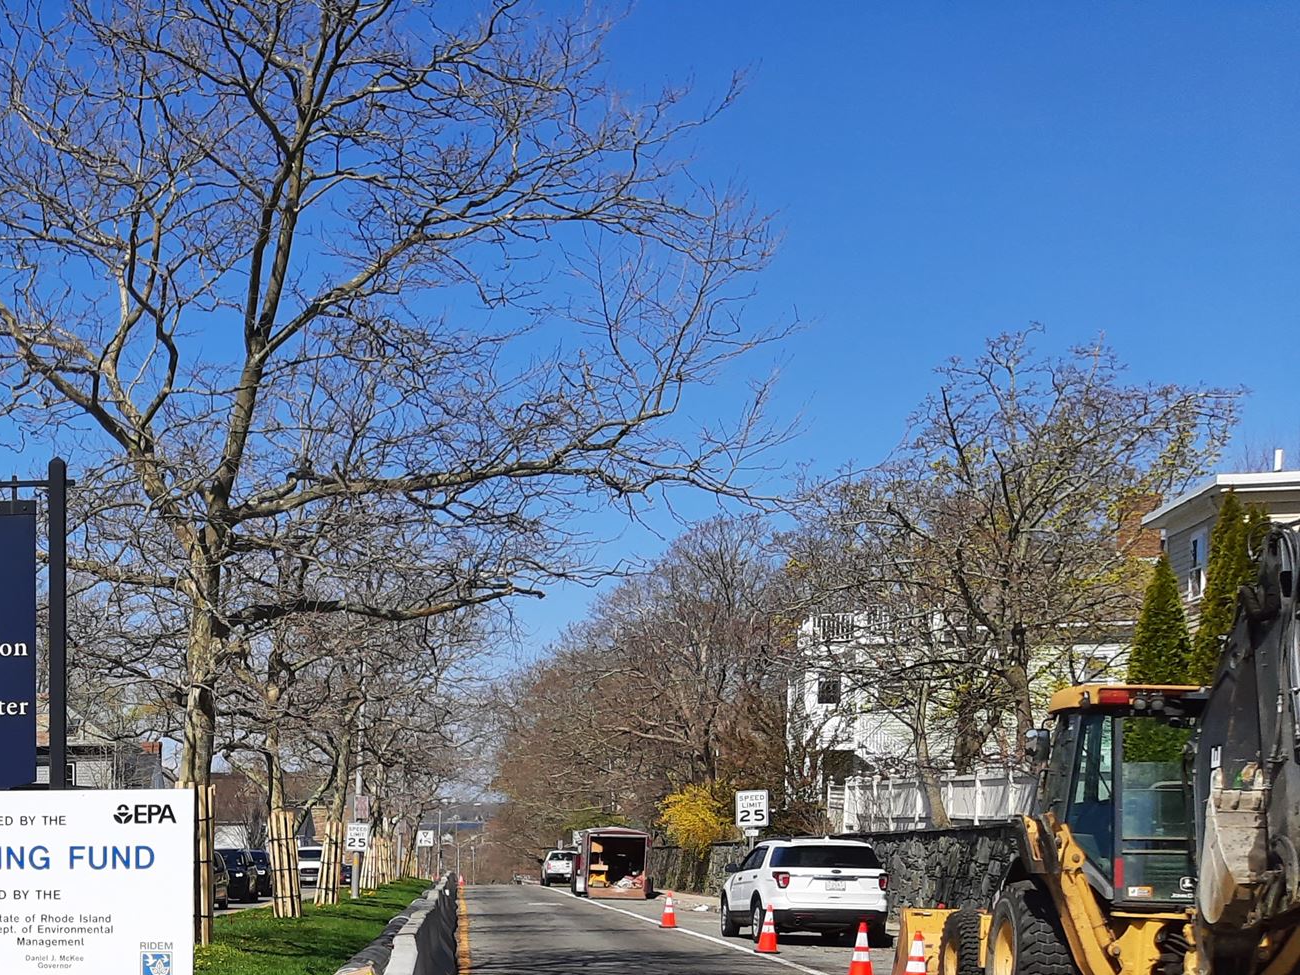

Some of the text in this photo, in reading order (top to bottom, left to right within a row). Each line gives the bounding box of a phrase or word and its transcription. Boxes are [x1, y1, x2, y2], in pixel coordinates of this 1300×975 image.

[134, 804, 176, 824] EPA
[740, 810, 765, 822] 25
[20, 816, 35, 825] BY
[42, 816, 66, 825] THE
[348, 838, 366, 847] 25
[70, 846, 155, 870] FUND
[14, 890, 29, 899] BY
[36, 890, 60, 900] THE
[25, 914, 34, 923] of
[40, 914, 74, 923] Rhode
[80, 914, 111, 923] Island
[22, 925, 32, 934] of
[38, 925, 113, 934] Environmental
[17, 937, 84, 947] Management
